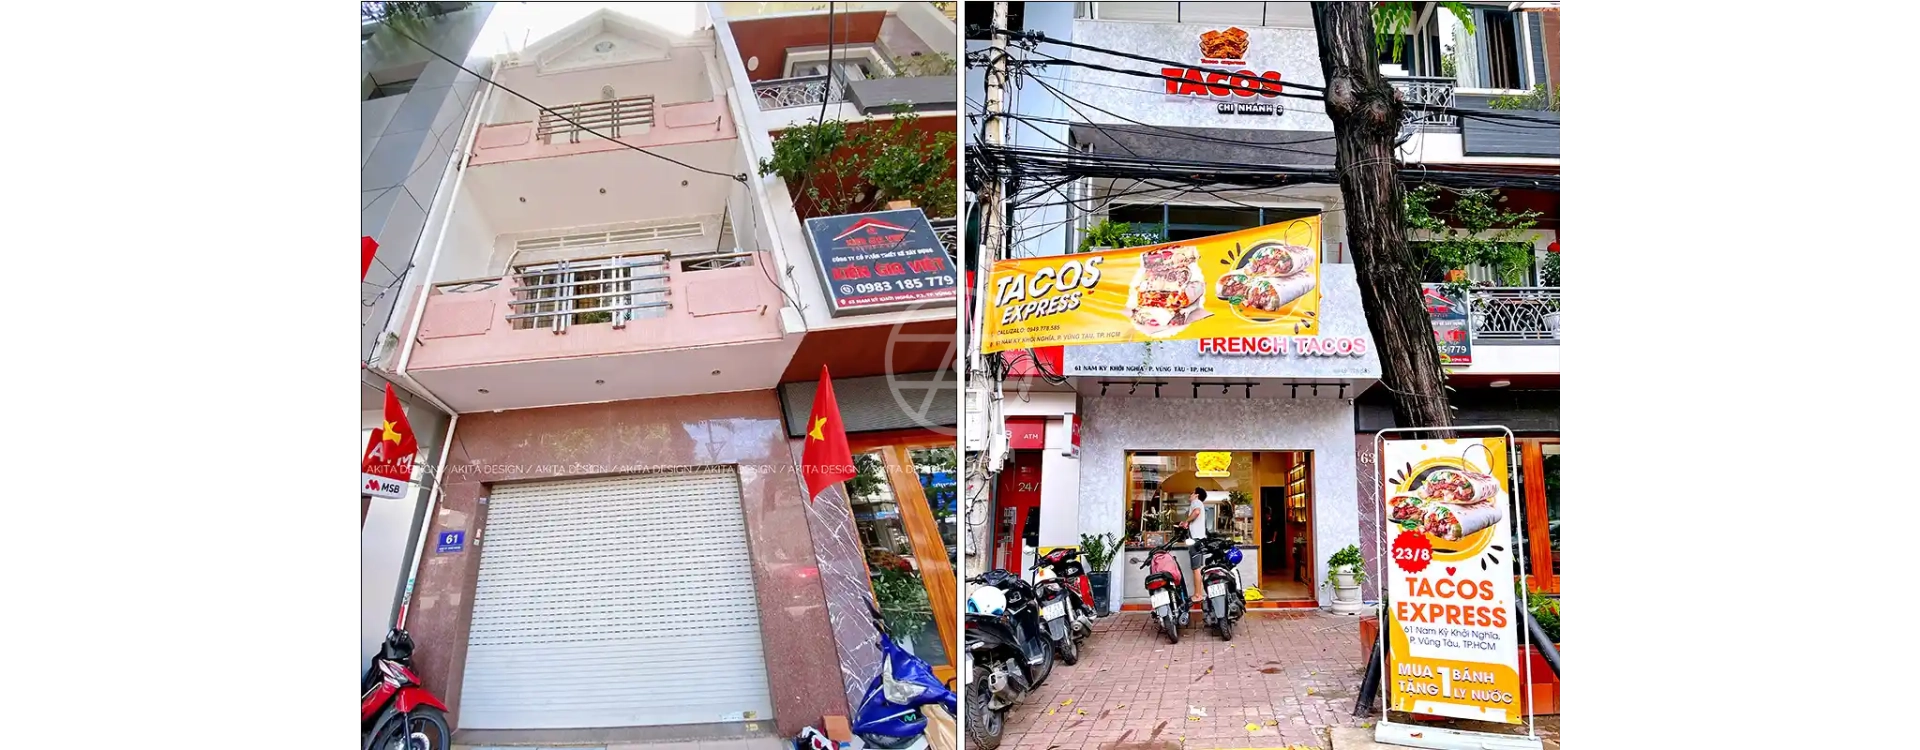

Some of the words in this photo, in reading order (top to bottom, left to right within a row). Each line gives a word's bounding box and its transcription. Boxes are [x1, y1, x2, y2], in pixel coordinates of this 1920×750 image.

[1161, 67, 1283, 98] TACOS
[1217, 103, 1235, 114] CHI
[856, 281, 892, 293] 0983
[895, 278, 923, 290] 185
[925, 275, 954, 286] 779
[995, 256, 1104, 308] TACOS
[1001, 292, 1083, 326] EXPRESS
[1199, 337, 1287, 353] FRENCH
[1295, 337, 1366, 353] TACOS
[368, 442, 414, 469] AM
[1361, 453, 1375, 463] 63
[381, 482, 400, 494] MSB
[1018, 482, 1040, 492] 24/
[445, 534, 459, 545] 61
[1396, 547, 1430, 560] 23/8
[1405, 577, 1494, 600] TACOS
[1398, 601, 1507, 628] EXPRESS
[1416, 626, 1436, 635] Nam
[1410, 636, 1416, 644] P.
[1418, 637, 1440, 648] Vũng
[1463, 640, 1496, 650] TP.HCM
[1398, 663, 1434, 679] MUA
[1437, 666, 1451, 698] 1
[1452, 667, 1494, 684] BÁNH
[1398, 679, 1438, 698] TẶNG
[1454, 688, 1467, 699] LY
[1471, 689, 1512, 703] NƯỚC
